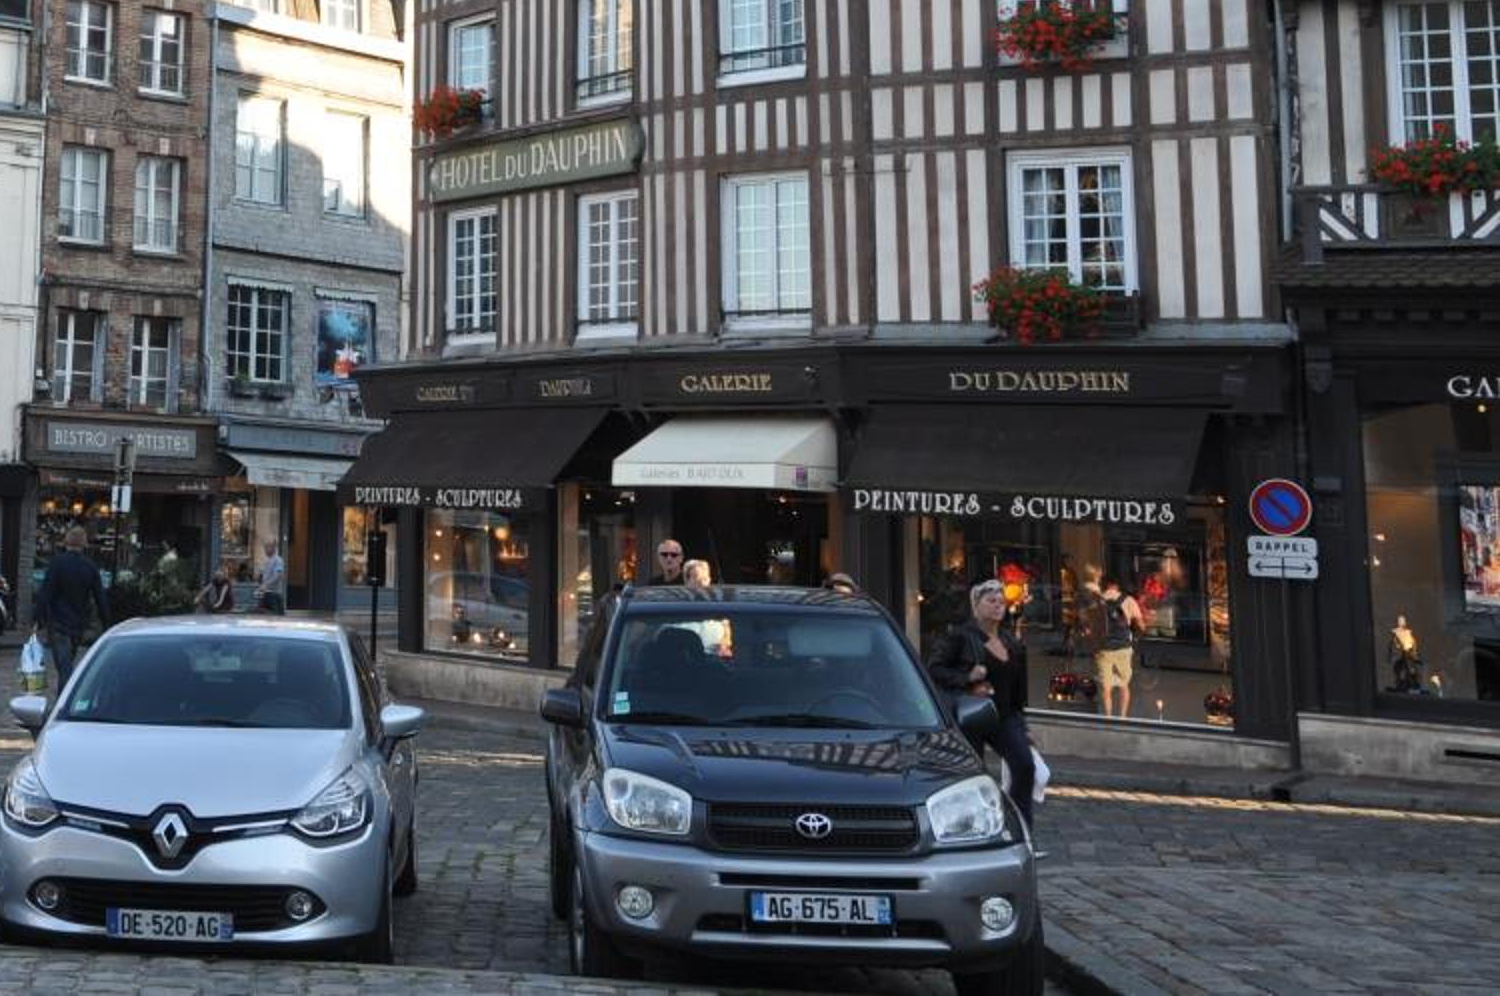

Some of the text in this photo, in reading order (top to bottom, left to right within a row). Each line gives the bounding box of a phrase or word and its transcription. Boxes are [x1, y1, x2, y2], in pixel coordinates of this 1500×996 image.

[441, 126, 627, 191] HOTEL DU DAUPHIN
[681, 375, 773, 393] GALERIE
[949, 371, 1129, 391] DU DAUPHIN
[54, 429, 107, 447] BISTRO
[355, 487, 421, 504] PEINTURES
[435, 489, 522, 507] SCULPTURES
[854, 489, 980, 515] PEINTURES
[1011, 496, 1175, 525] SCULPTURES
[1255, 542, 1309, 553] RAPPEL
